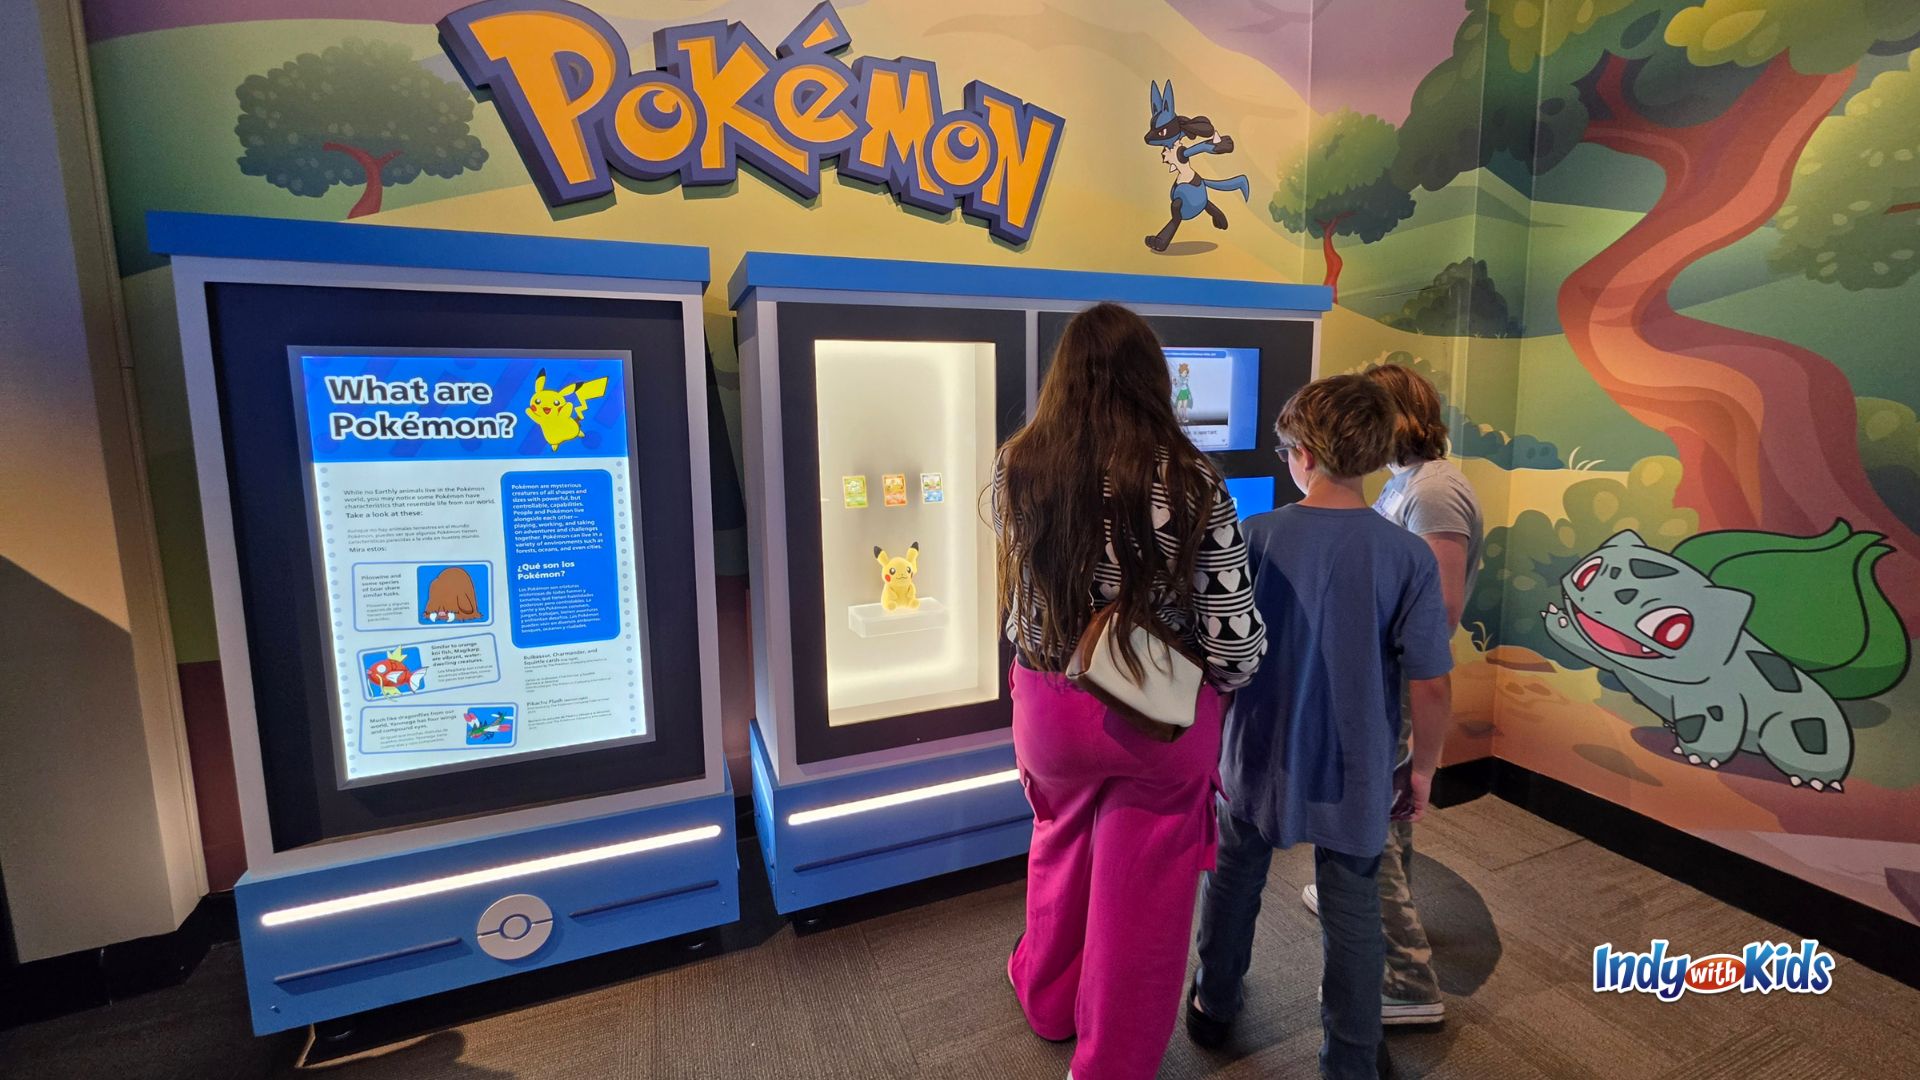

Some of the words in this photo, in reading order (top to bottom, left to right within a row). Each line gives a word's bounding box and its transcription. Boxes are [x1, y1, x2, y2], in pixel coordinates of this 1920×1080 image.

[326, 376, 428, 403] What
[436, 384, 492, 403] are
[331, 412, 516, 438] Pokémon?
[518, 563, 540, 572] ¿Qué
[518, 570, 565, 580] Pokémon?
